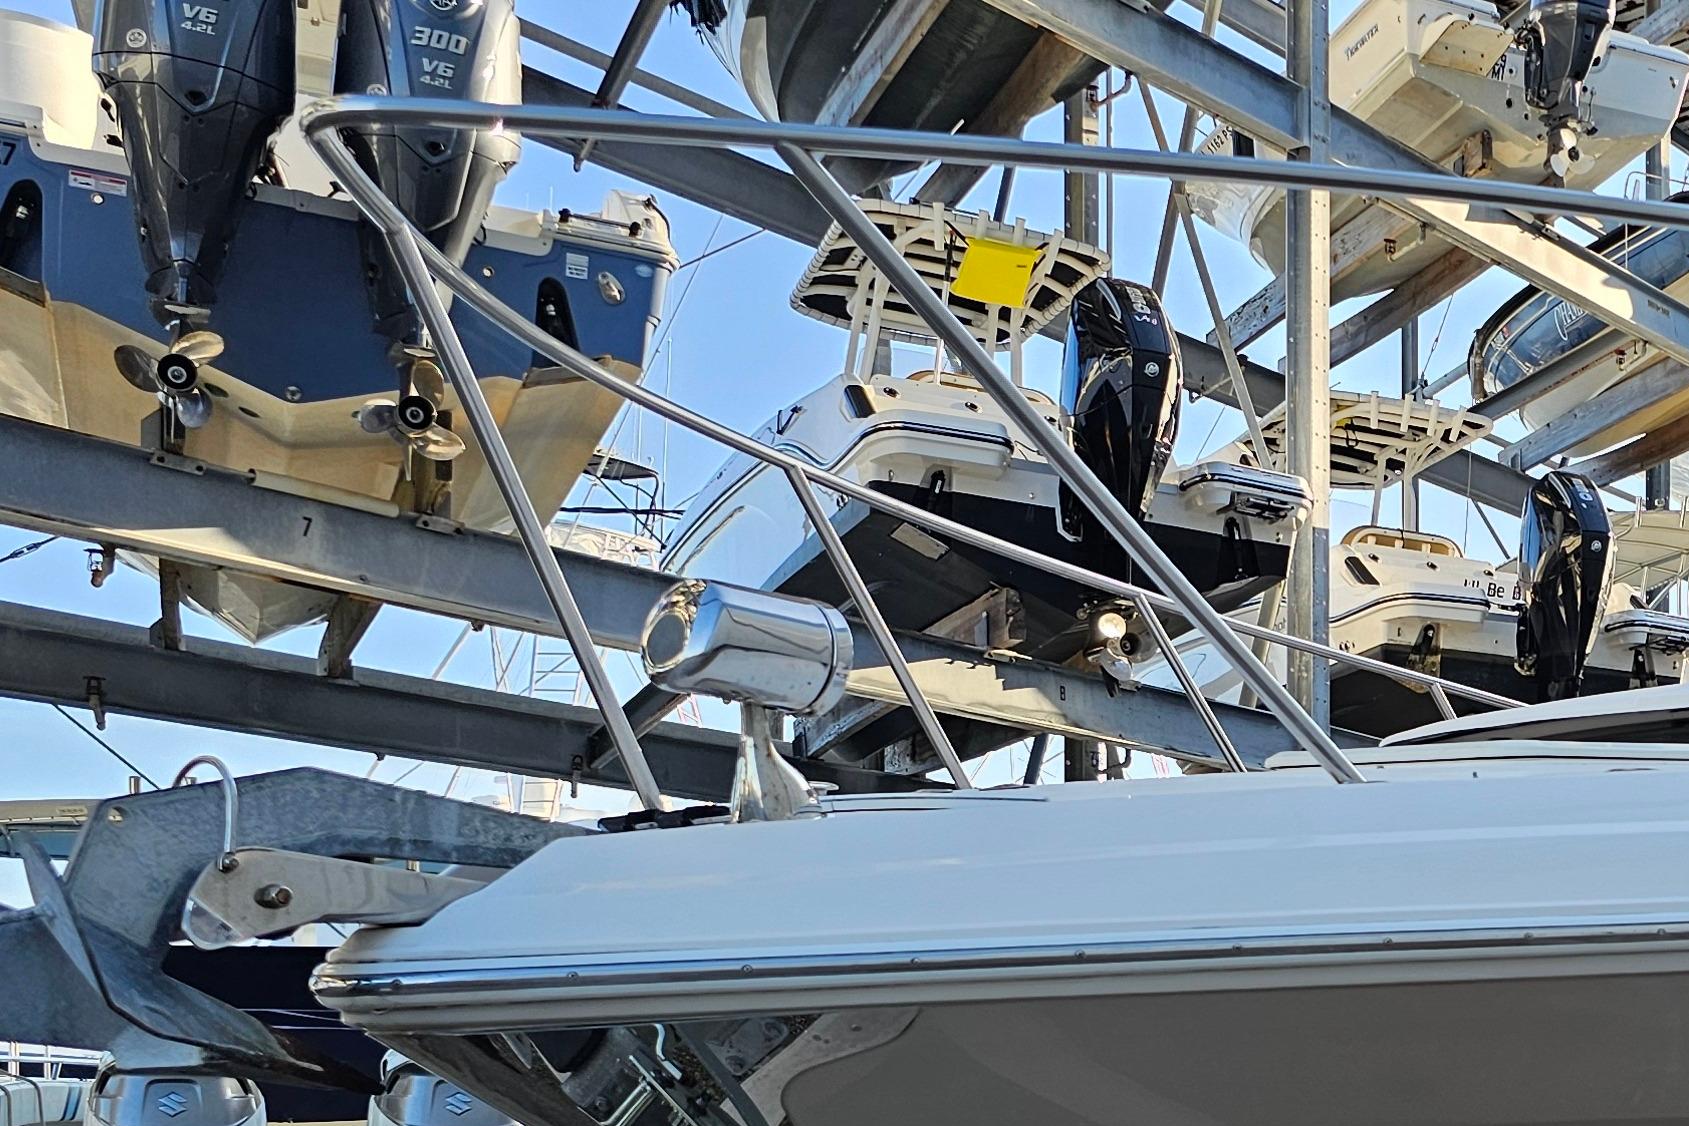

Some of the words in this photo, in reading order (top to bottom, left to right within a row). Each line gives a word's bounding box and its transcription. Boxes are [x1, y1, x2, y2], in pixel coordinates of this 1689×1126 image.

[182, 3, 219, 23] V6
[181, 21, 216, 35] 4.2L
[410, 25, 470, 55] 300
[422, 57, 456, 78] V6
[420, 75, 454, 90] 4.2L
[302, 516, 313, 537] 7
